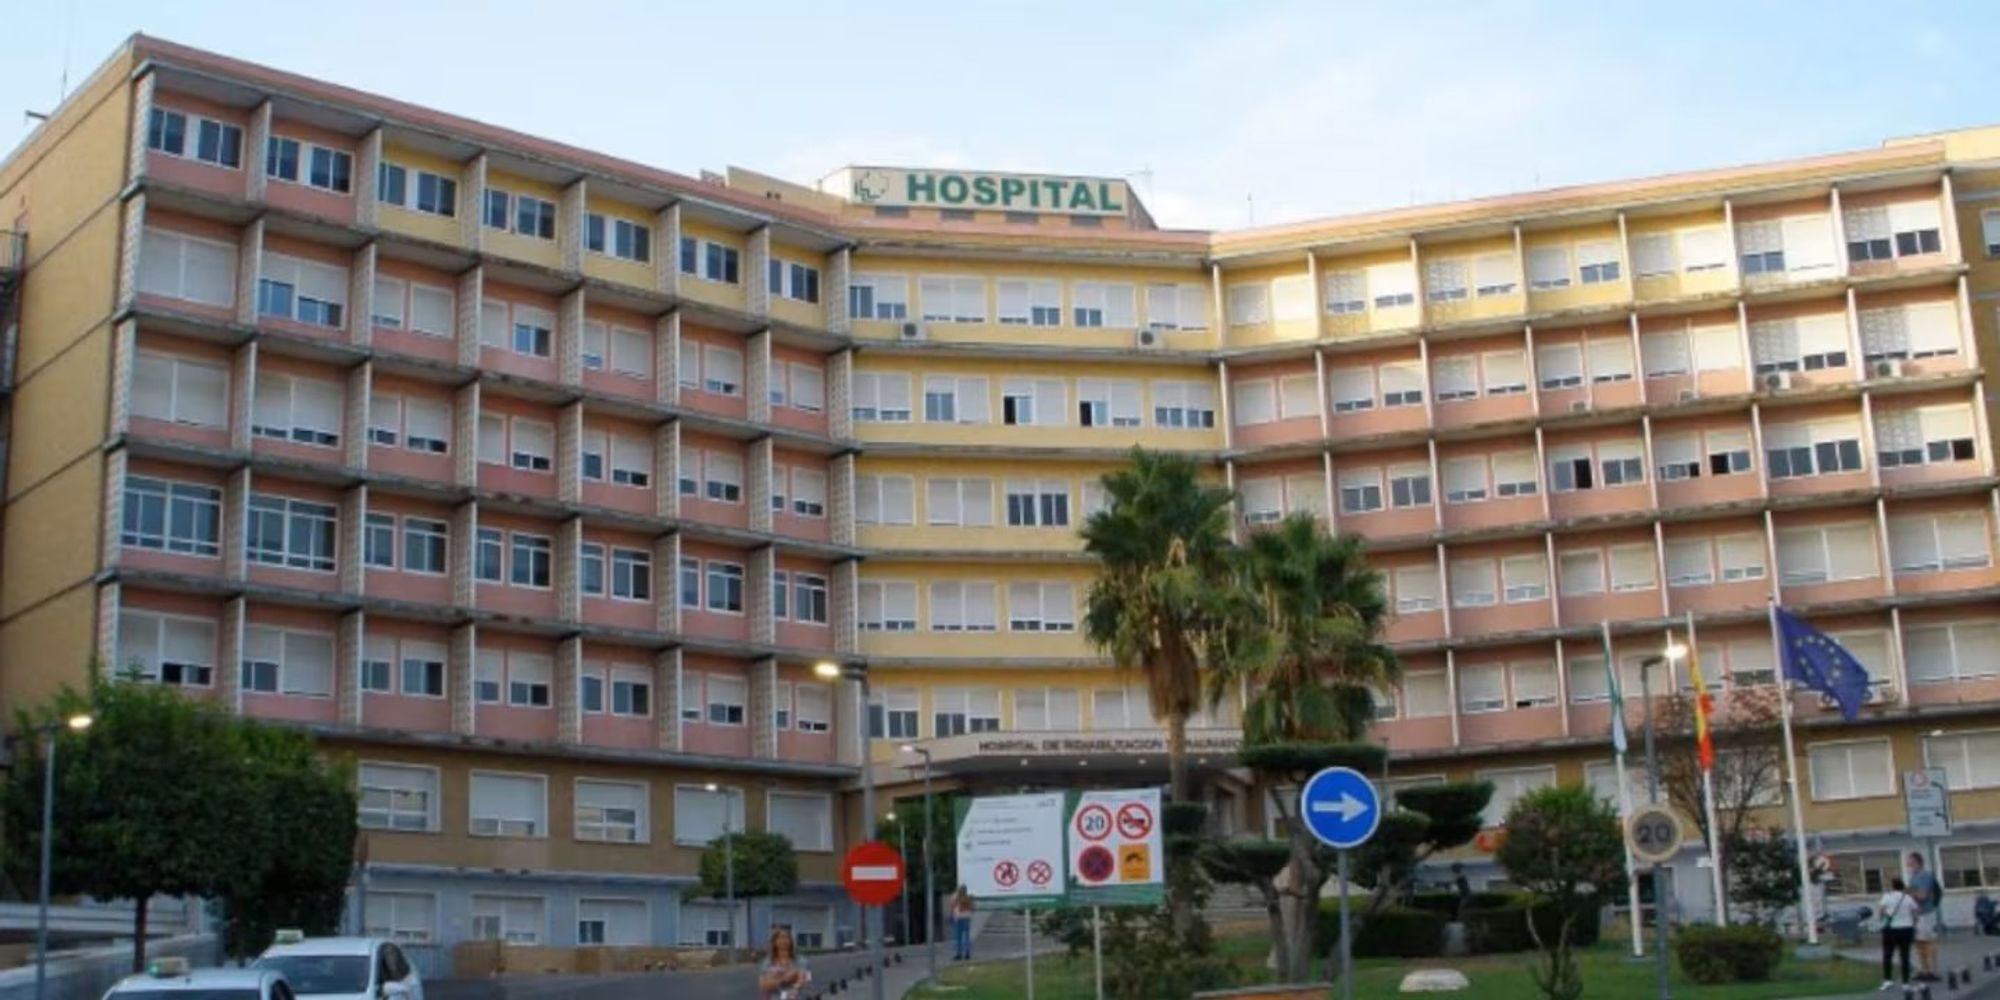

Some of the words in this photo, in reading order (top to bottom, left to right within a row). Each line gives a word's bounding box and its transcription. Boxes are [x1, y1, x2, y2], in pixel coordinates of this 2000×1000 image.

[907, 174, 1122, 210] HOSPITAL
[1085, 815, 1105, 830] 20
[1637, 824, 1671, 843] 20
